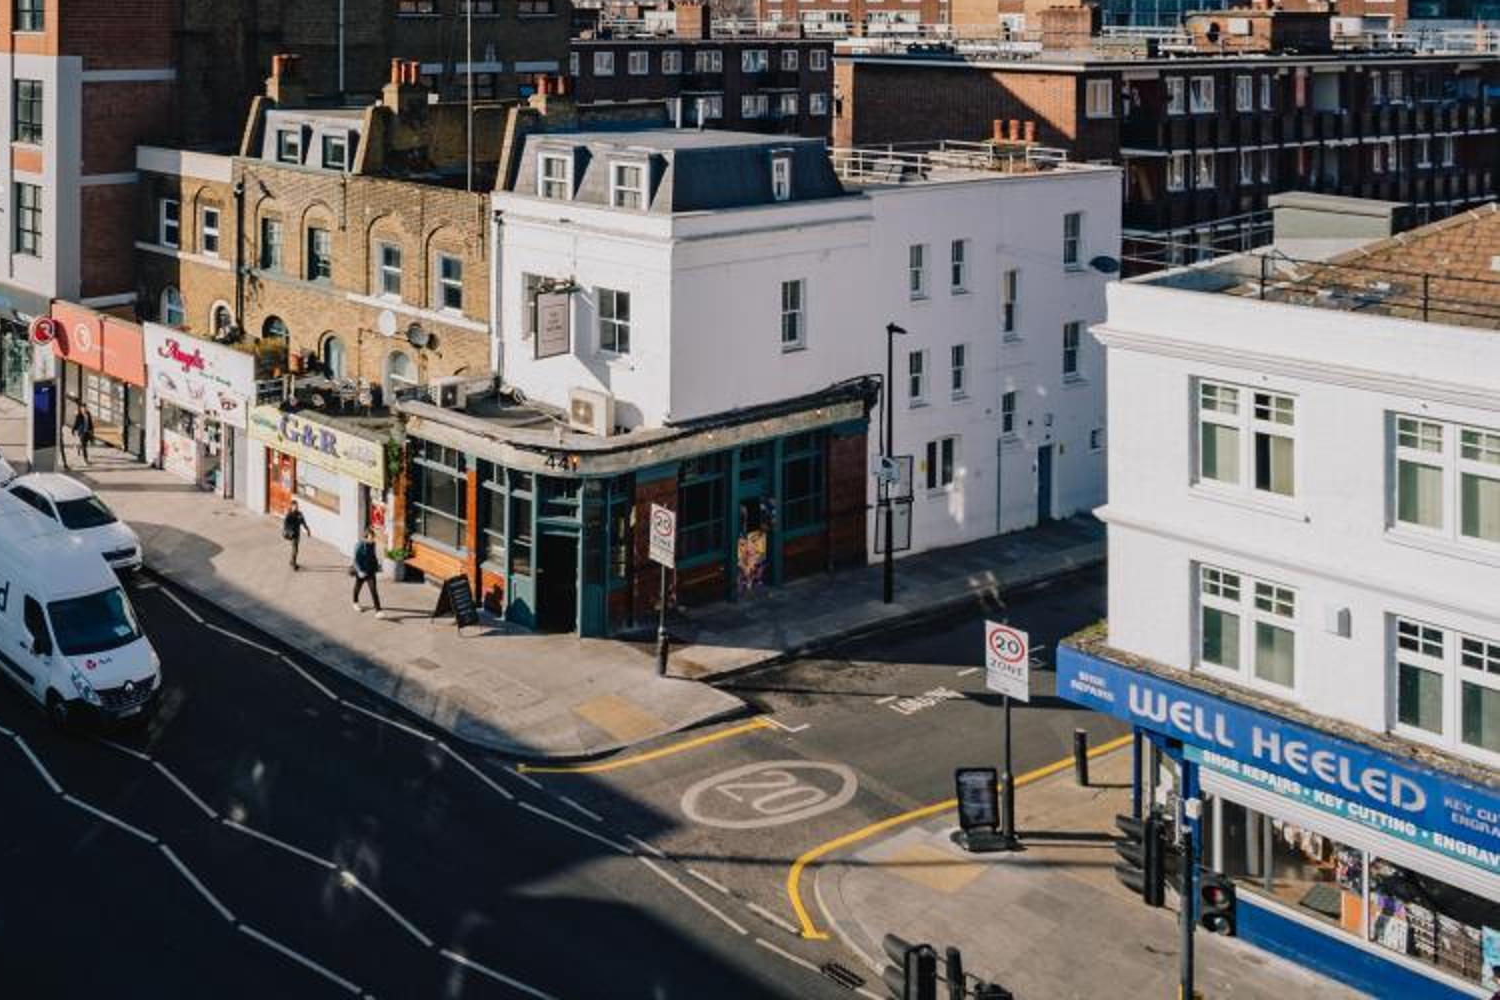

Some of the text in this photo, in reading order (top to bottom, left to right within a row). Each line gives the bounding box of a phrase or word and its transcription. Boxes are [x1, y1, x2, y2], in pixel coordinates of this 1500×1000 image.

[995, 635, 1020, 655] 20
[989, 657, 1025, 677] ZONE
[1128, 682, 1427, 813] WELL HEELED
[715, 769, 827, 815] 20
[1203, 750, 1240, 773] SHOE
[1242, 764, 1301, 795] REPAIRS
[1313, 789, 1344, 810] KEY
[1347, 801, 1418, 837] CUTTING
[1443, 796, 1473, 814] KEY
